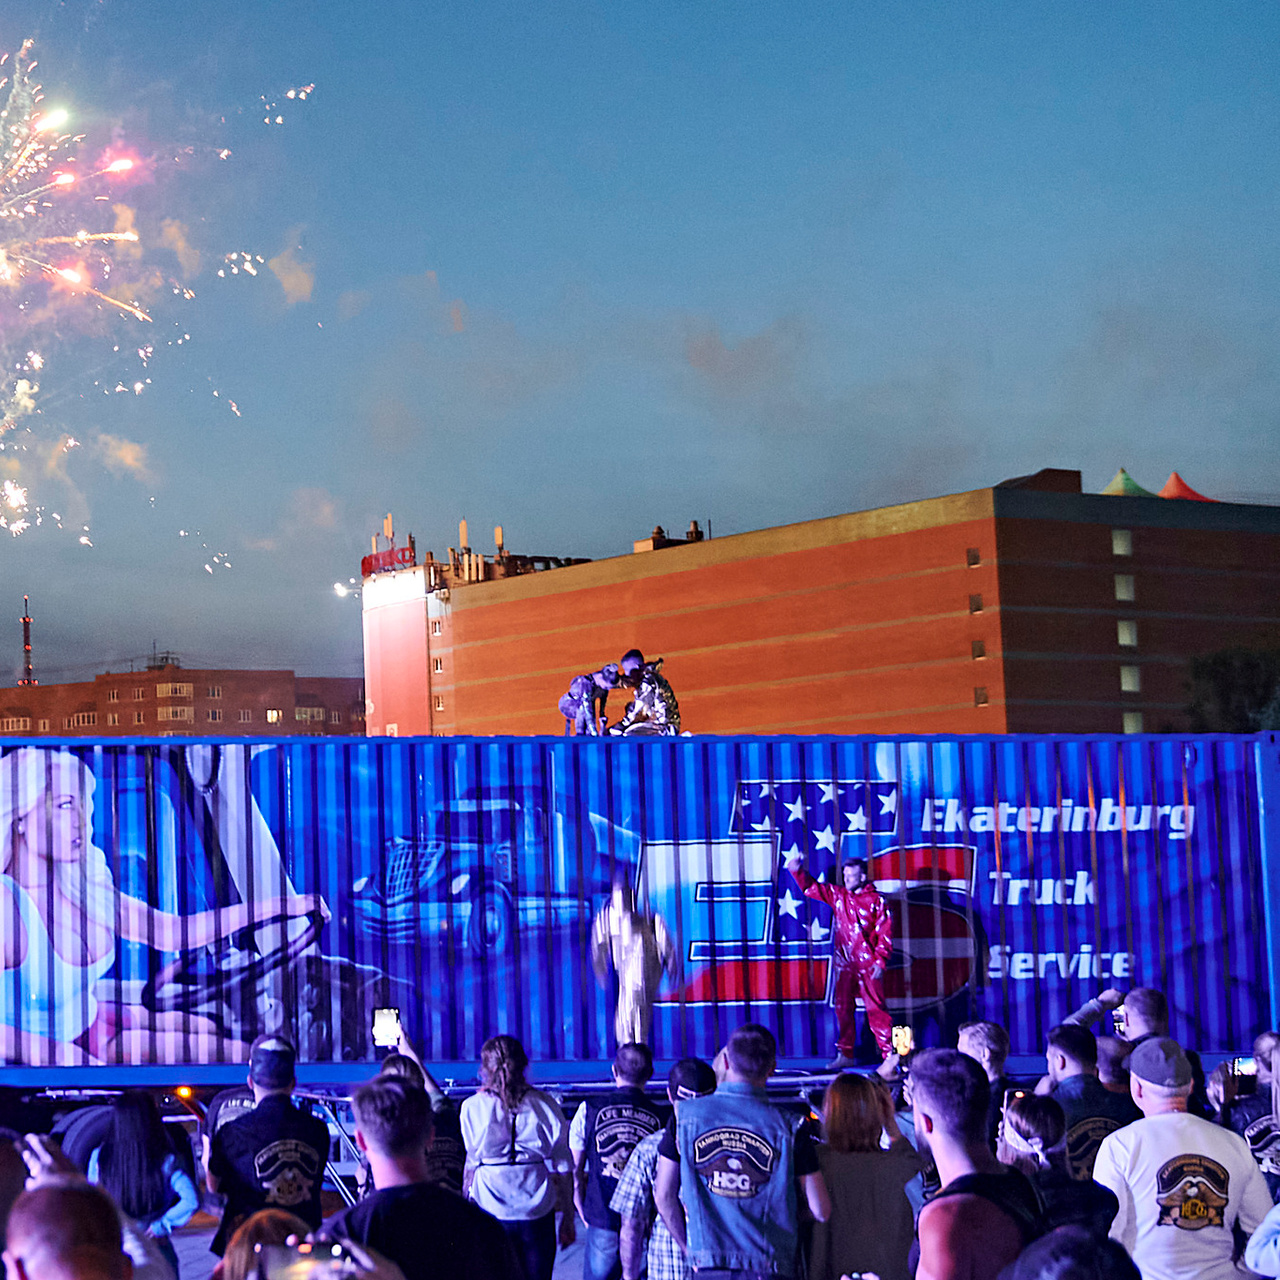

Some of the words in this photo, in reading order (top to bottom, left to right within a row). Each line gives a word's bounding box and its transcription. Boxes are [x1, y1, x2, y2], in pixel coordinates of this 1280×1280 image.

[921, 797, 1195, 840] Ekaterinburg
[989, 871, 1098, 905] Truck
[987, 944, 1135, 979] Service
[713, 1170, 750, 1190] HOG
